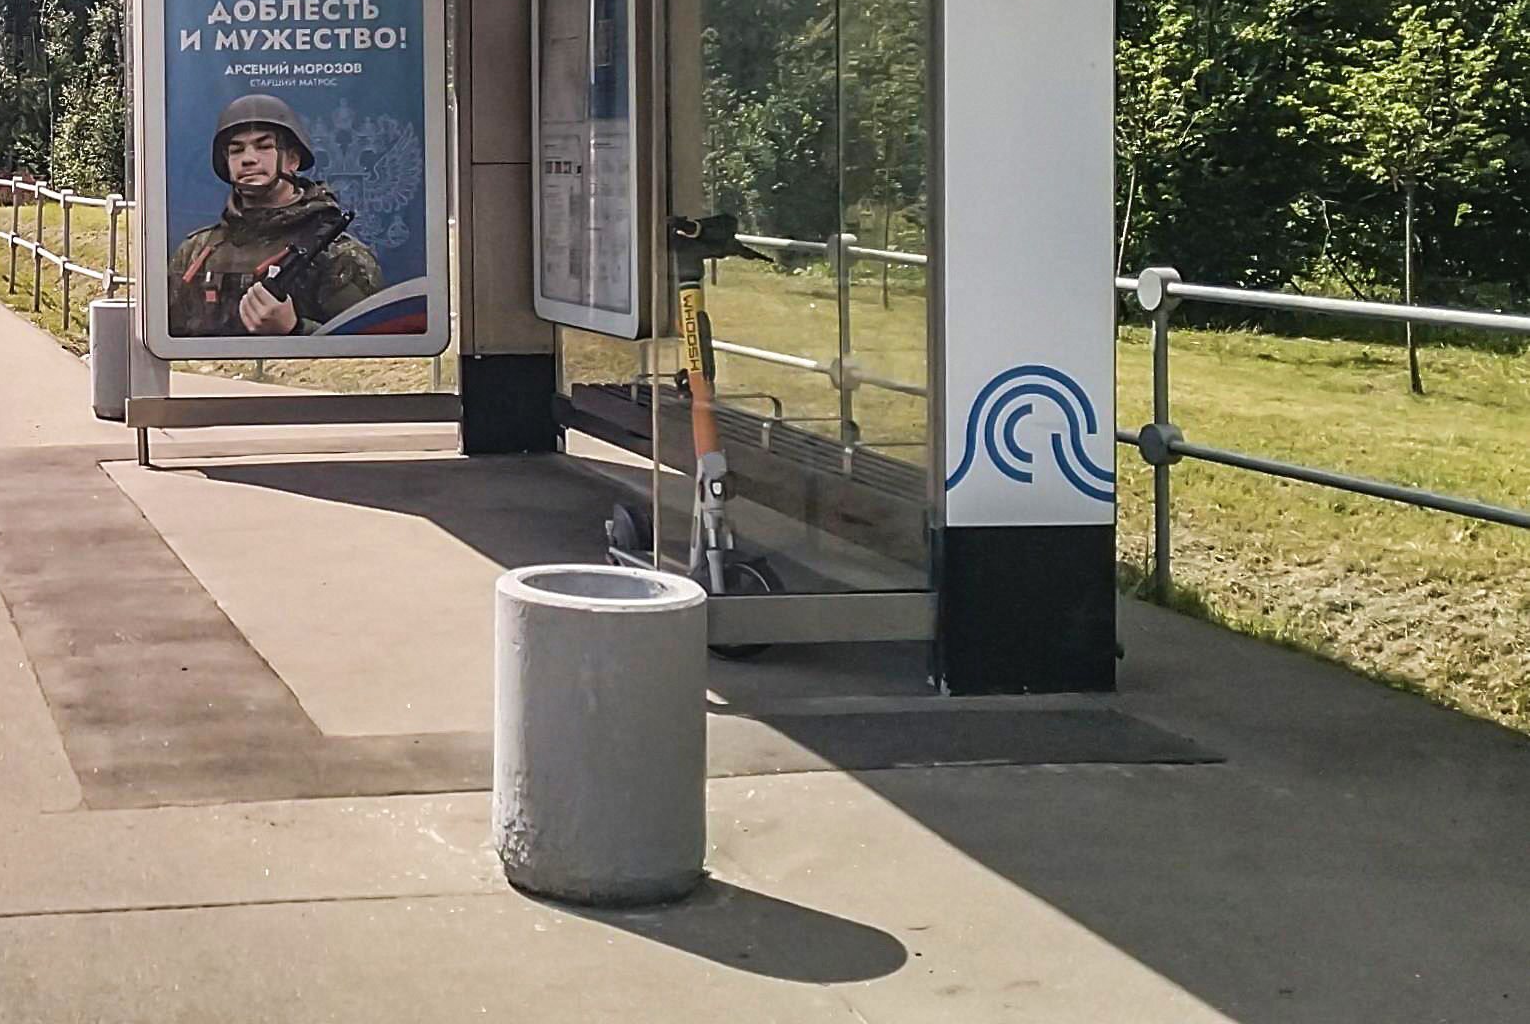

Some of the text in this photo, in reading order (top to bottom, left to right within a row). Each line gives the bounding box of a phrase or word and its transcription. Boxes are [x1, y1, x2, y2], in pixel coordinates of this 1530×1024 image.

[180, 27, 407, 51] И МУЖЕСТВО!
[225, 61, 363, 75] АРСЕНИЙ МОРОЗОВ
[299, 77, 338, 87] МАТРОС
[683, 294, 703, 372] WHOOSH
